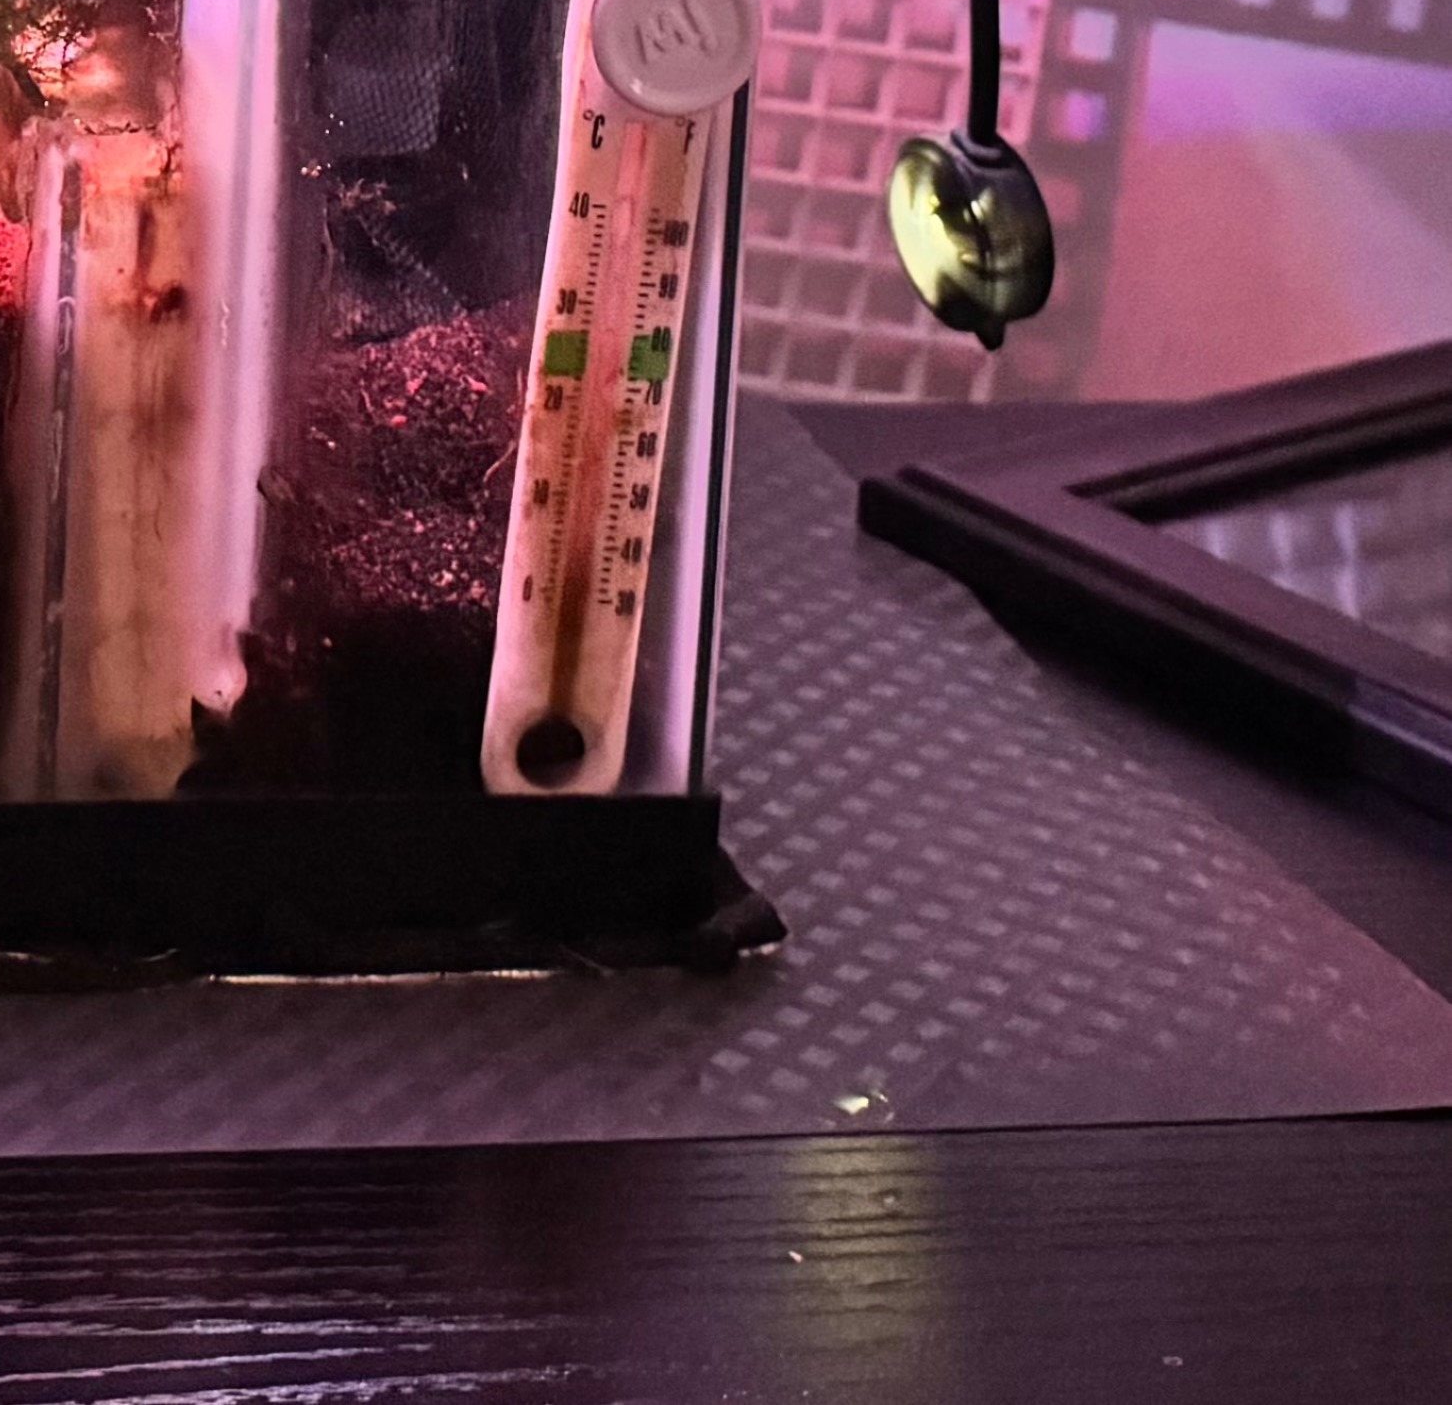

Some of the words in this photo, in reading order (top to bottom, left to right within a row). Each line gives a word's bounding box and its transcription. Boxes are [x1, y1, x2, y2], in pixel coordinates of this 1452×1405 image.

[568, 191, 590, 219] 40
[658, 273, 679, 300] 90
[555, 288, 576, 316] 30
[543, 384, 563, 412] 20
[644, 378, 663, 406] 70
[635, 432, 657, 459] 60
[531, 479, 550, 506] 10
[629, 482, 649, 511] 50
[620, 537, 643, 565] 40
[522, 575, 534, 603] 0
[614, 589, 637, 618] 30
